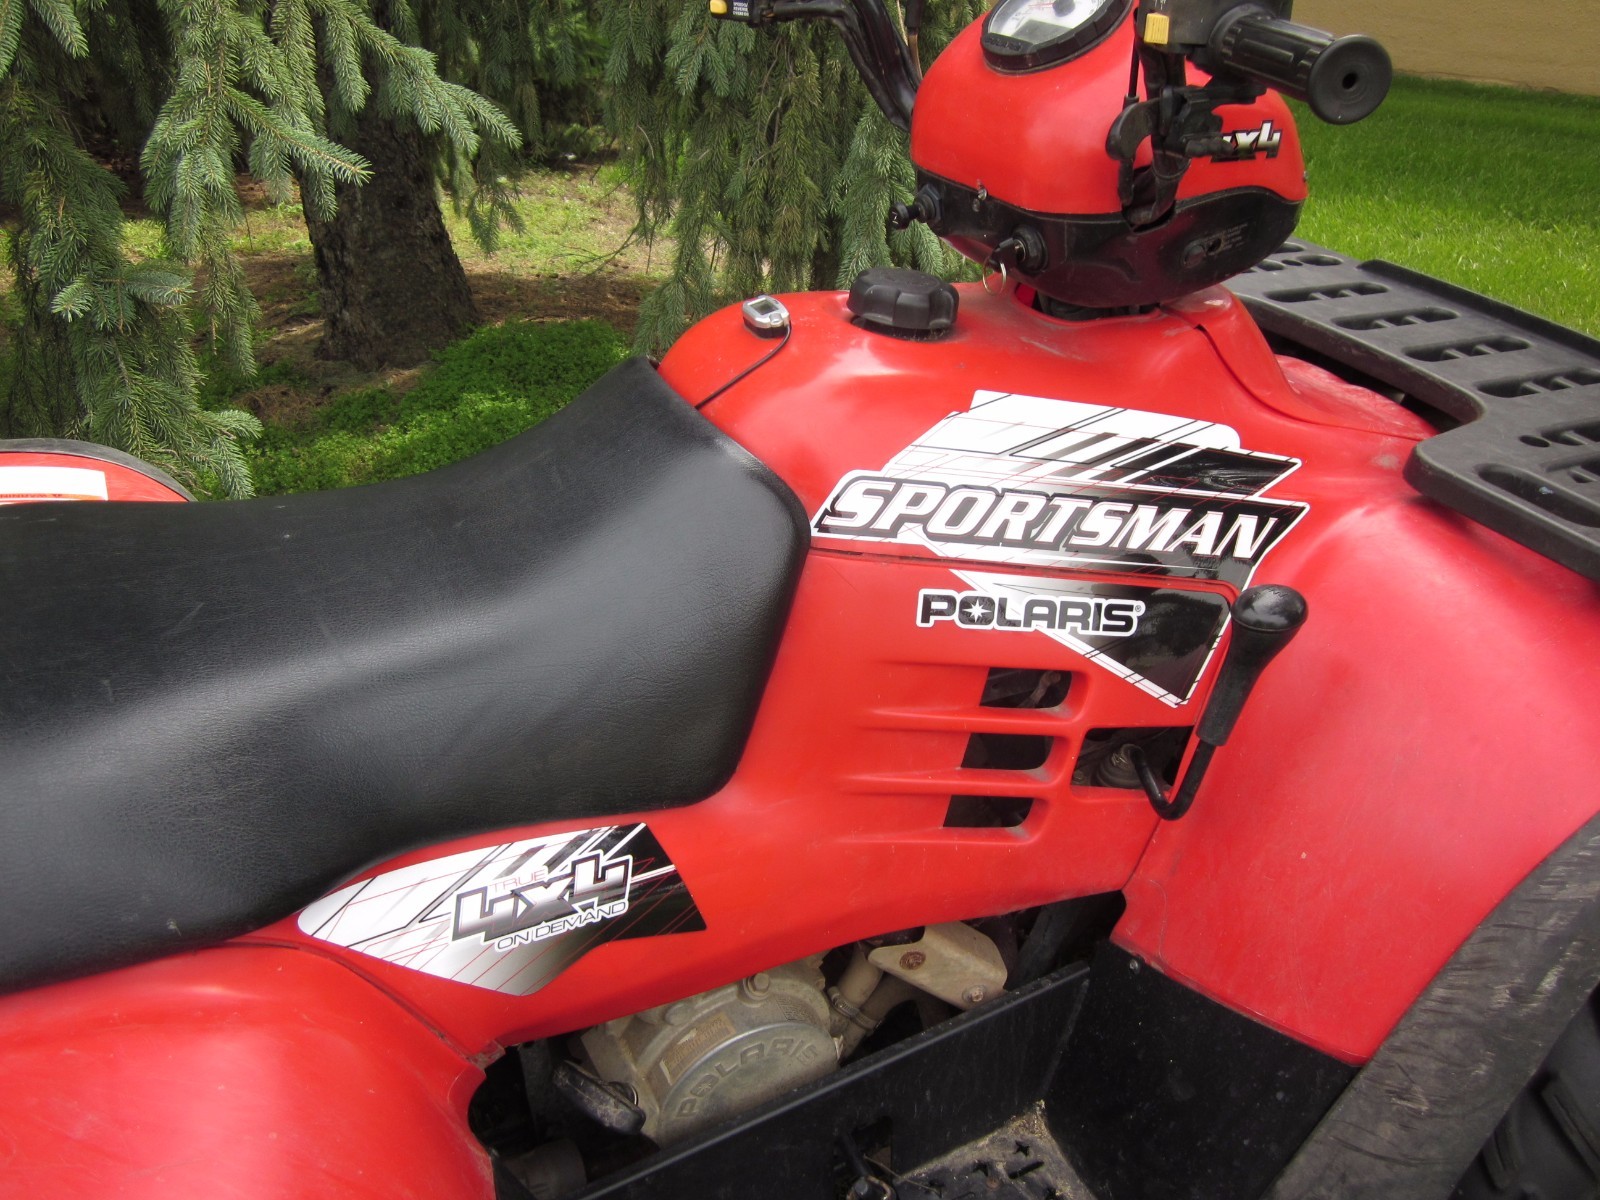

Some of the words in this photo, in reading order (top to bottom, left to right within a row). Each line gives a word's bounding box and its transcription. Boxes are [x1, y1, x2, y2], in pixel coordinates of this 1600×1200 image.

[1211, 120, 1282, 162] x4
[824, 477, 1277, 560] SPORTSMAN
[489, 869, 545, 893] TRUE
[497, 930, 530, 950] ON
[535, 902, 627, 937] DEMAND
[675, 1035, 818, 1119] POLARIS
